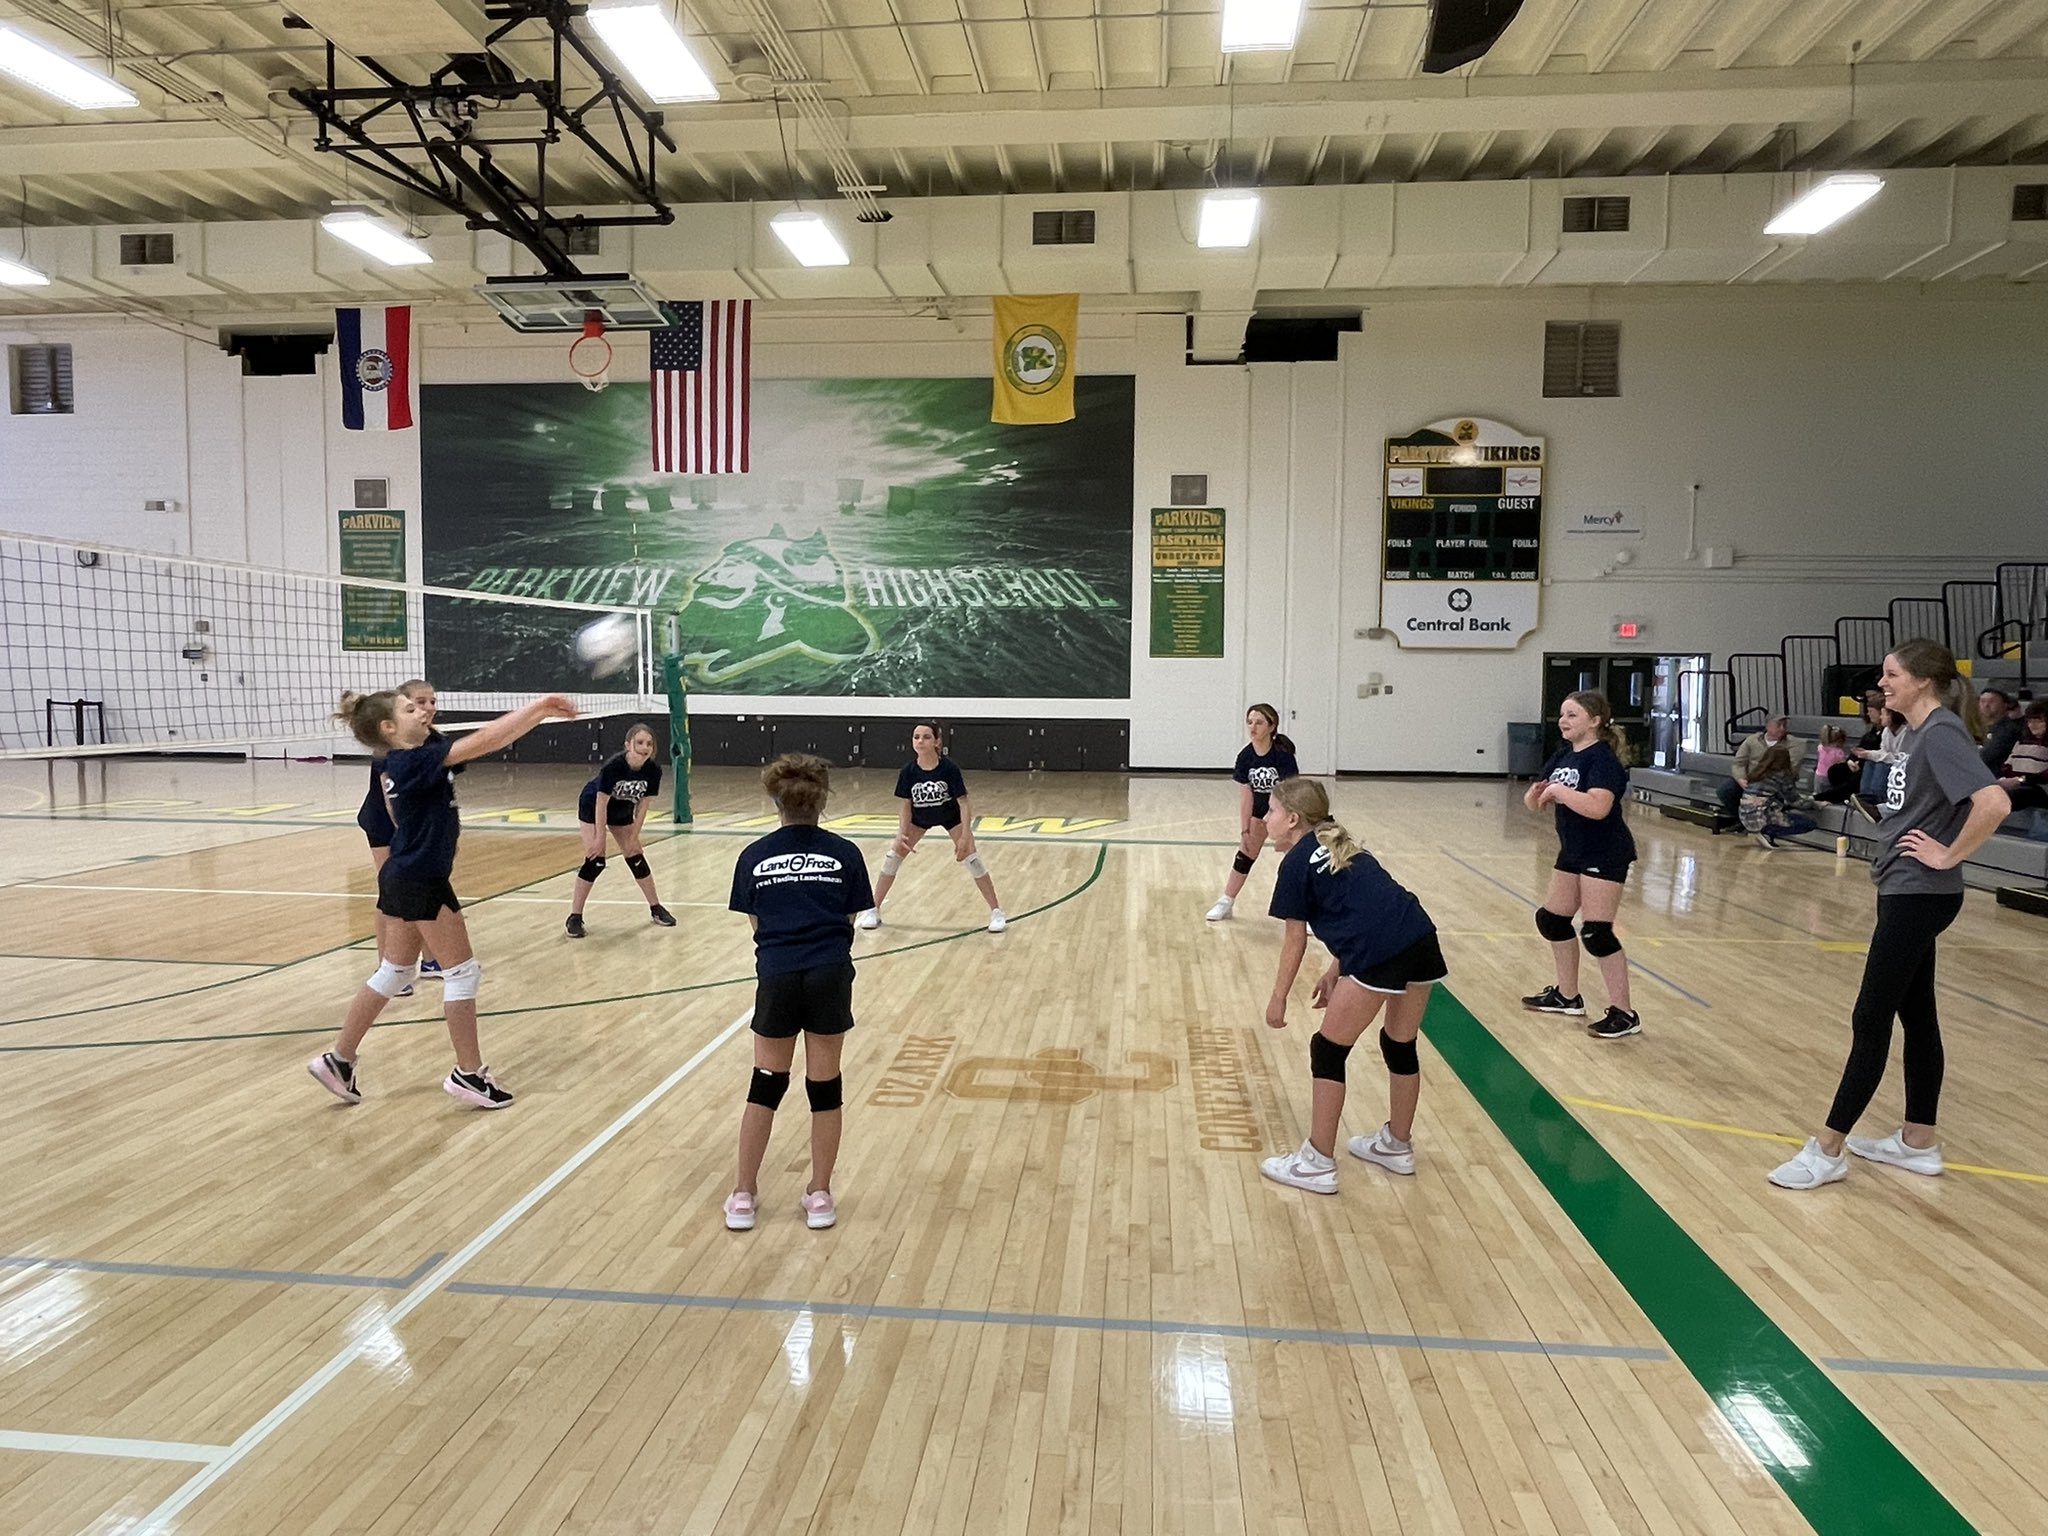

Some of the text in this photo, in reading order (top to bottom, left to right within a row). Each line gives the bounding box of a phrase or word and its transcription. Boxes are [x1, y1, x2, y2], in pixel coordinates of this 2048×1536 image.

[1391, 498, 1434, 509] VIKINGS
[1449, 504, 1477, 512] PERIOD
[1498, 498, 1536, 510] GUEST
[342, 513, 402, 529] PARKVIEW
[1154, 510, 1222, 526] PARKVIEW
[1583, 515, 1615, 526] Mercy
[1387, 539, 1412, 548] FOULS
[1435, 539, 1489, 548] PLAYER FOUL
[1512, 539, 1538, 548] FOULS
[1448, 571, 1475, 579] MATCH
[450, 568, 674, 606] PARKVIEW
[1406, 616, 1511, 631] Central Bank
[760, 859, 789, 873] Land
[868, 1034, 957, 1107] OZARK
